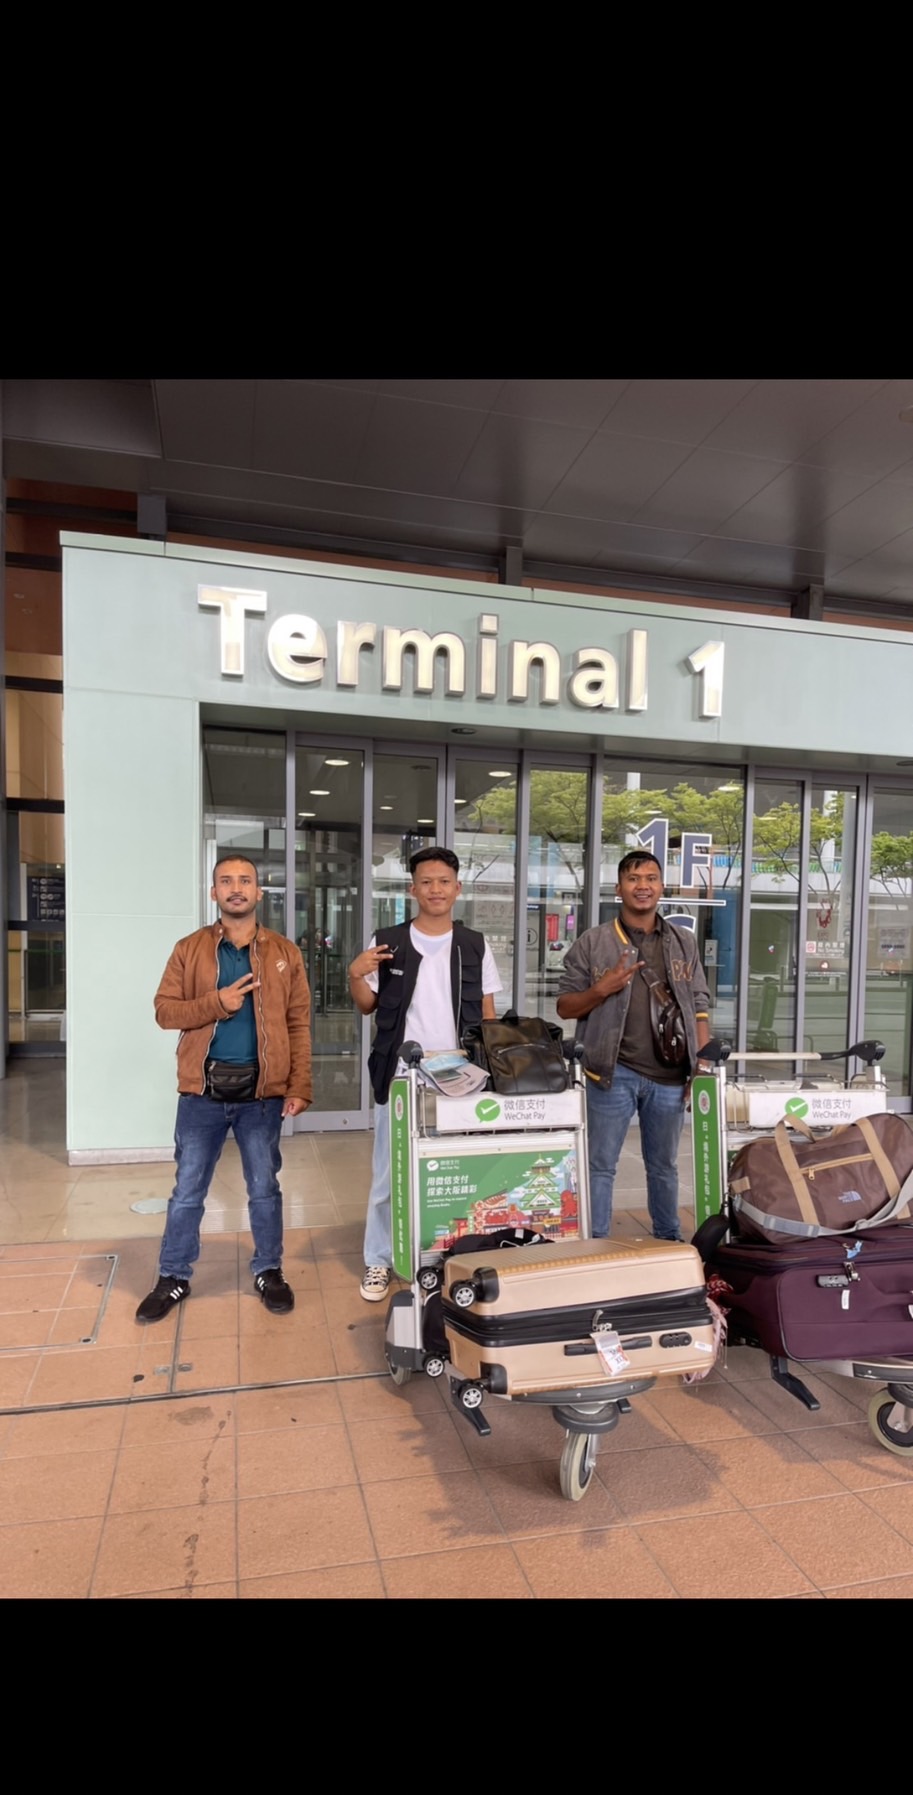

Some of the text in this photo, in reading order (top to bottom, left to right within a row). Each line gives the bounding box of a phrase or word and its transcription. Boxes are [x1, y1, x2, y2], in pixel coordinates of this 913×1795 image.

[197, 584, 726, 719] Terminal 1
[635, 818, 712, 888] 1F
[503, 1099, 545, 1110] 微信支付
[812, 1098, 851, 1109] 微信支付
[504, 1111, 546, 1120] WeChat Pay
[812, 1110, 851, 1120] WeChat Pay
